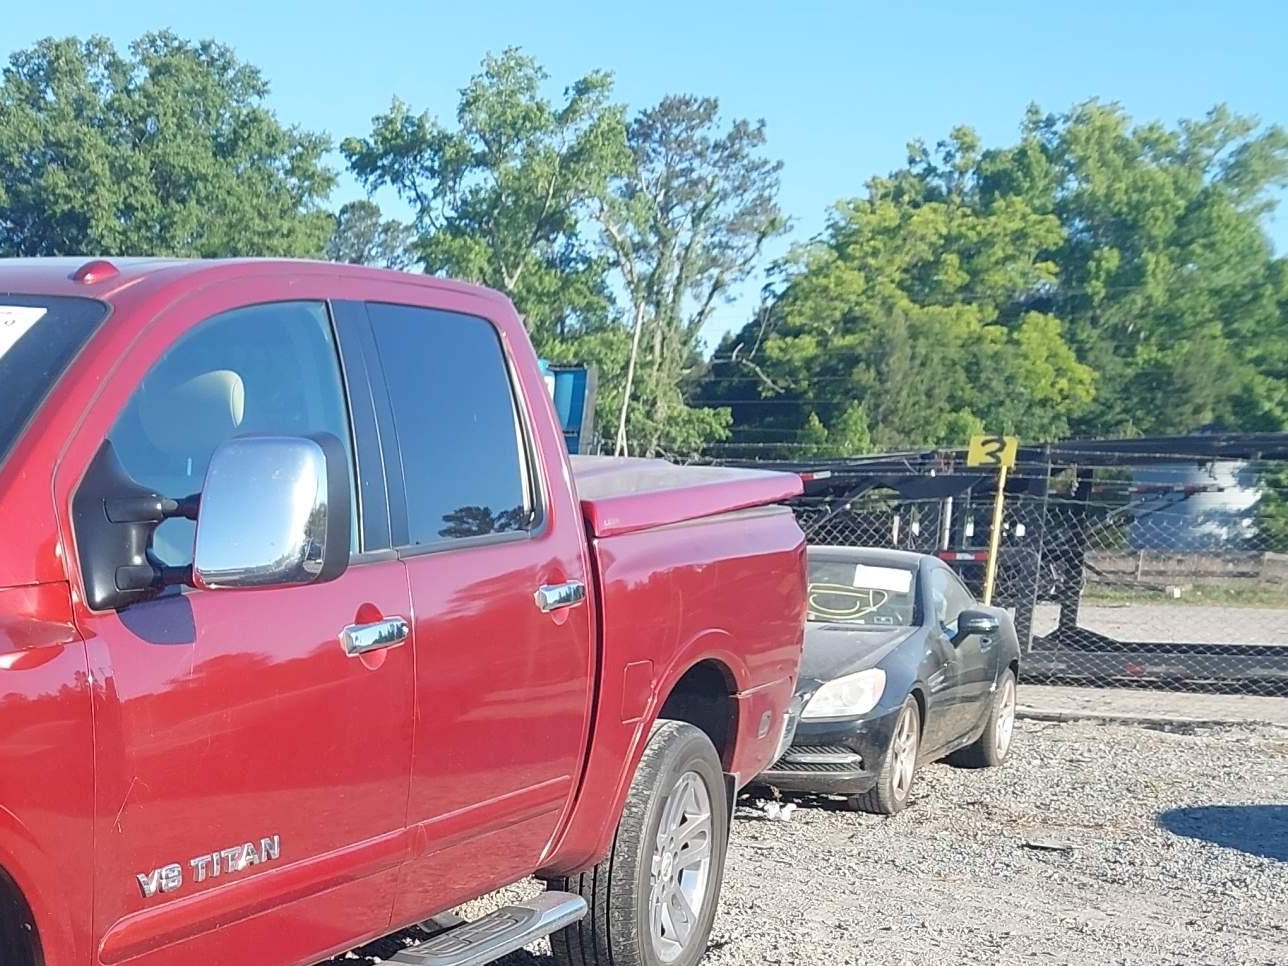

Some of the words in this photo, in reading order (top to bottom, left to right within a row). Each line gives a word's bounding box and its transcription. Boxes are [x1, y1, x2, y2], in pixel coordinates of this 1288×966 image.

[979, 438, 1007, 465] 3
[137, 863, 183, 897] V8
[190, 835, 280, 882] TITAN
